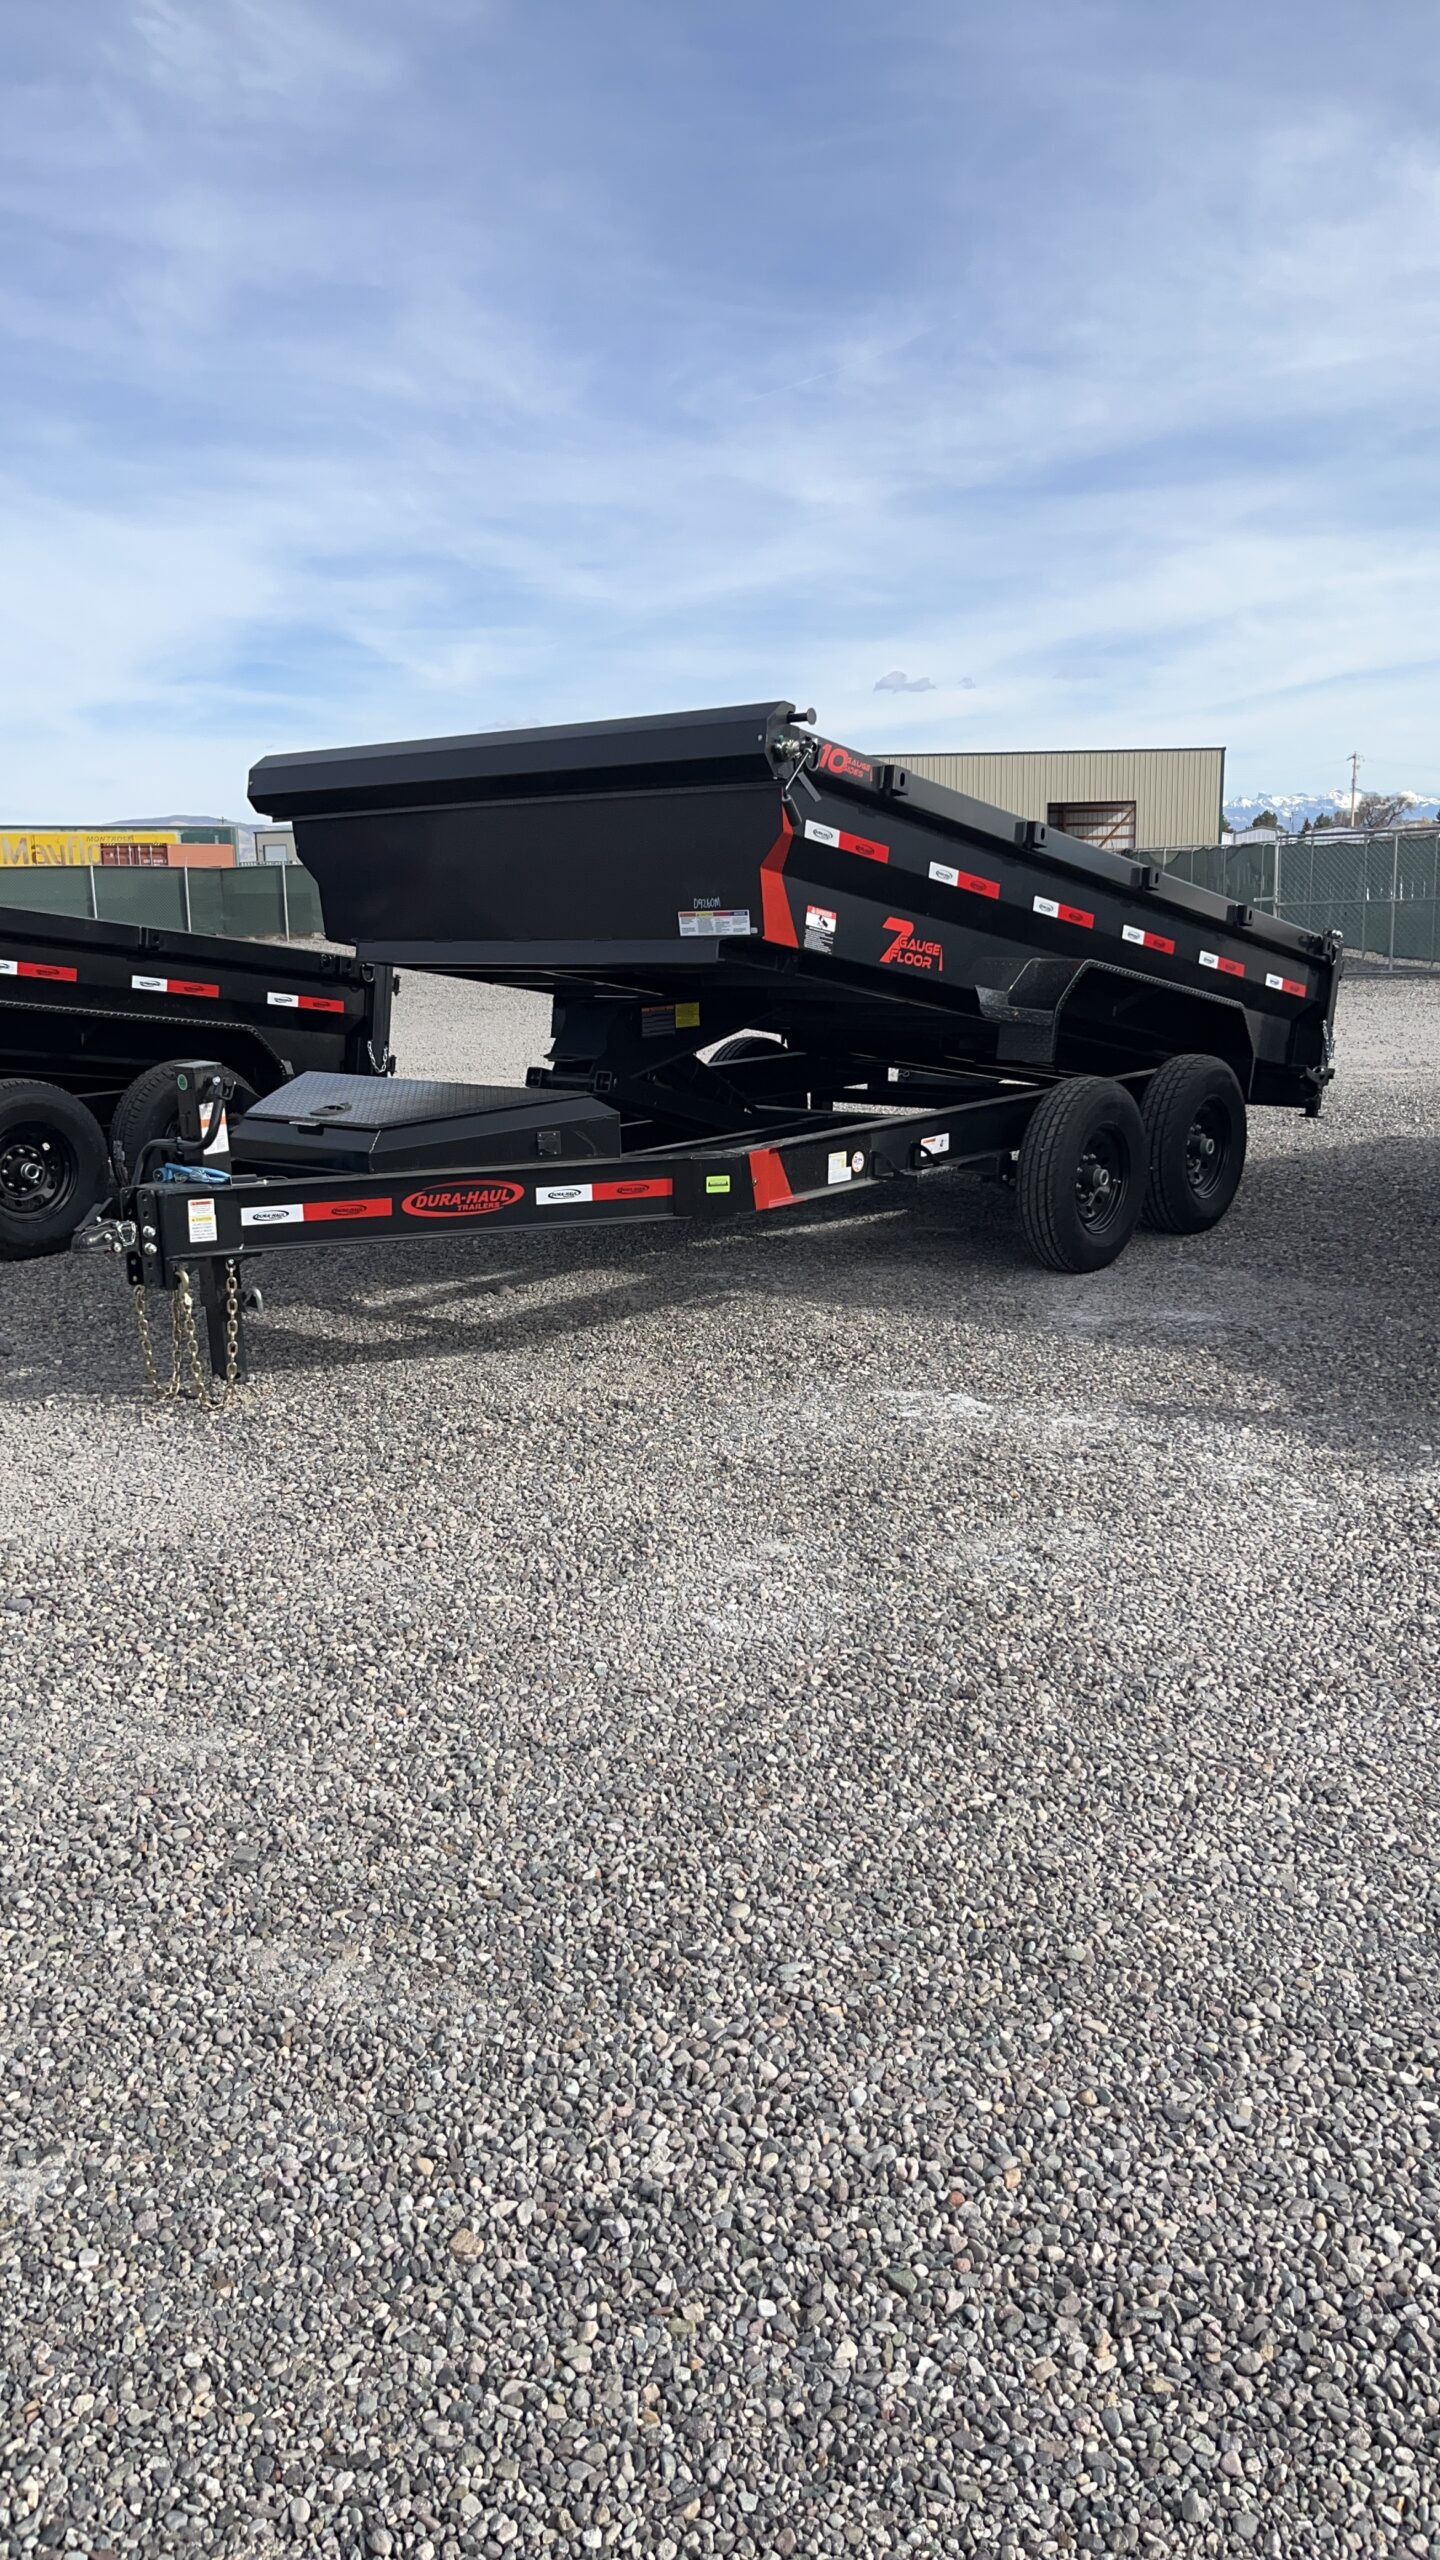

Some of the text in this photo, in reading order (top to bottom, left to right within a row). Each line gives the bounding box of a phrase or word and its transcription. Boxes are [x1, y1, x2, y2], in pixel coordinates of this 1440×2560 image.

[820, 743, 849, 774] 10
[880, 916, 914, 964] 7
[900, 936, 942, 956] GAUGE
[890, 948, 932, 969] FLOOR
[415, 1188, 510, 1209] DURA-HAUL
[457, 1201, 500, 1212] TRAILERS
